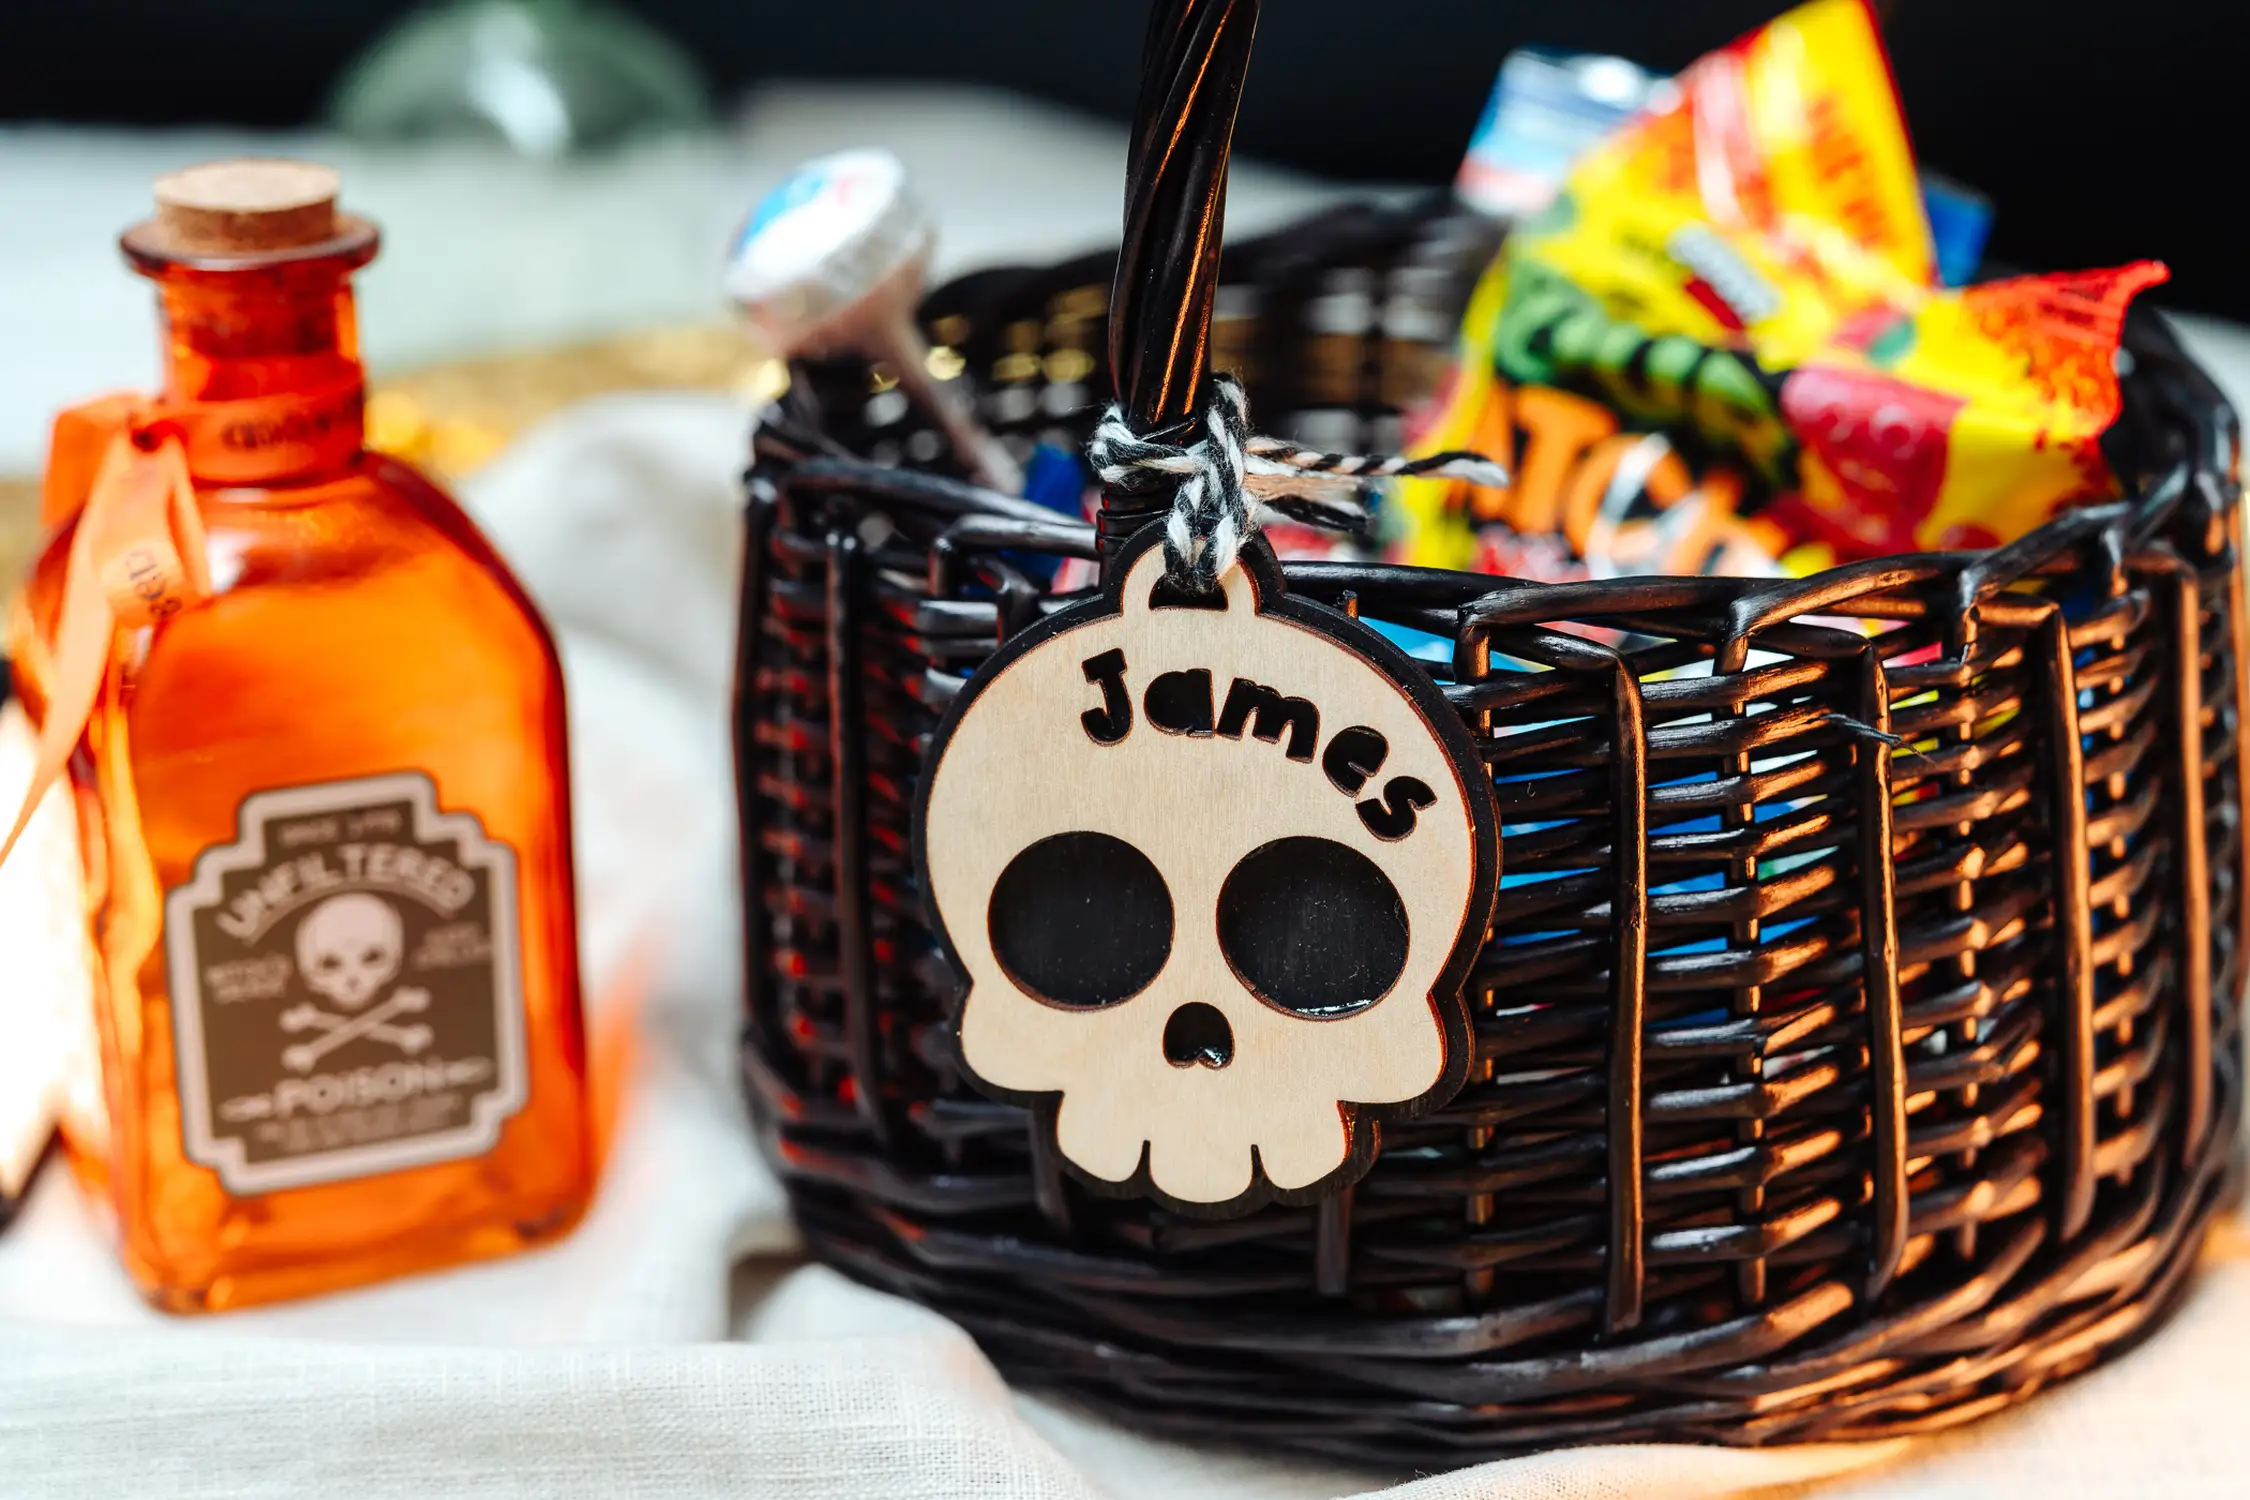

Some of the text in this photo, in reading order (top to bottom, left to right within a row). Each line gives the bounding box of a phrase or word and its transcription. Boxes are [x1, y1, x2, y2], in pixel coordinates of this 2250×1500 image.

[1080, 647, 1439, 844] James
[215, 842, 476, 940] UNFILTERED
[273, 1056, 446, 1120] POISON
